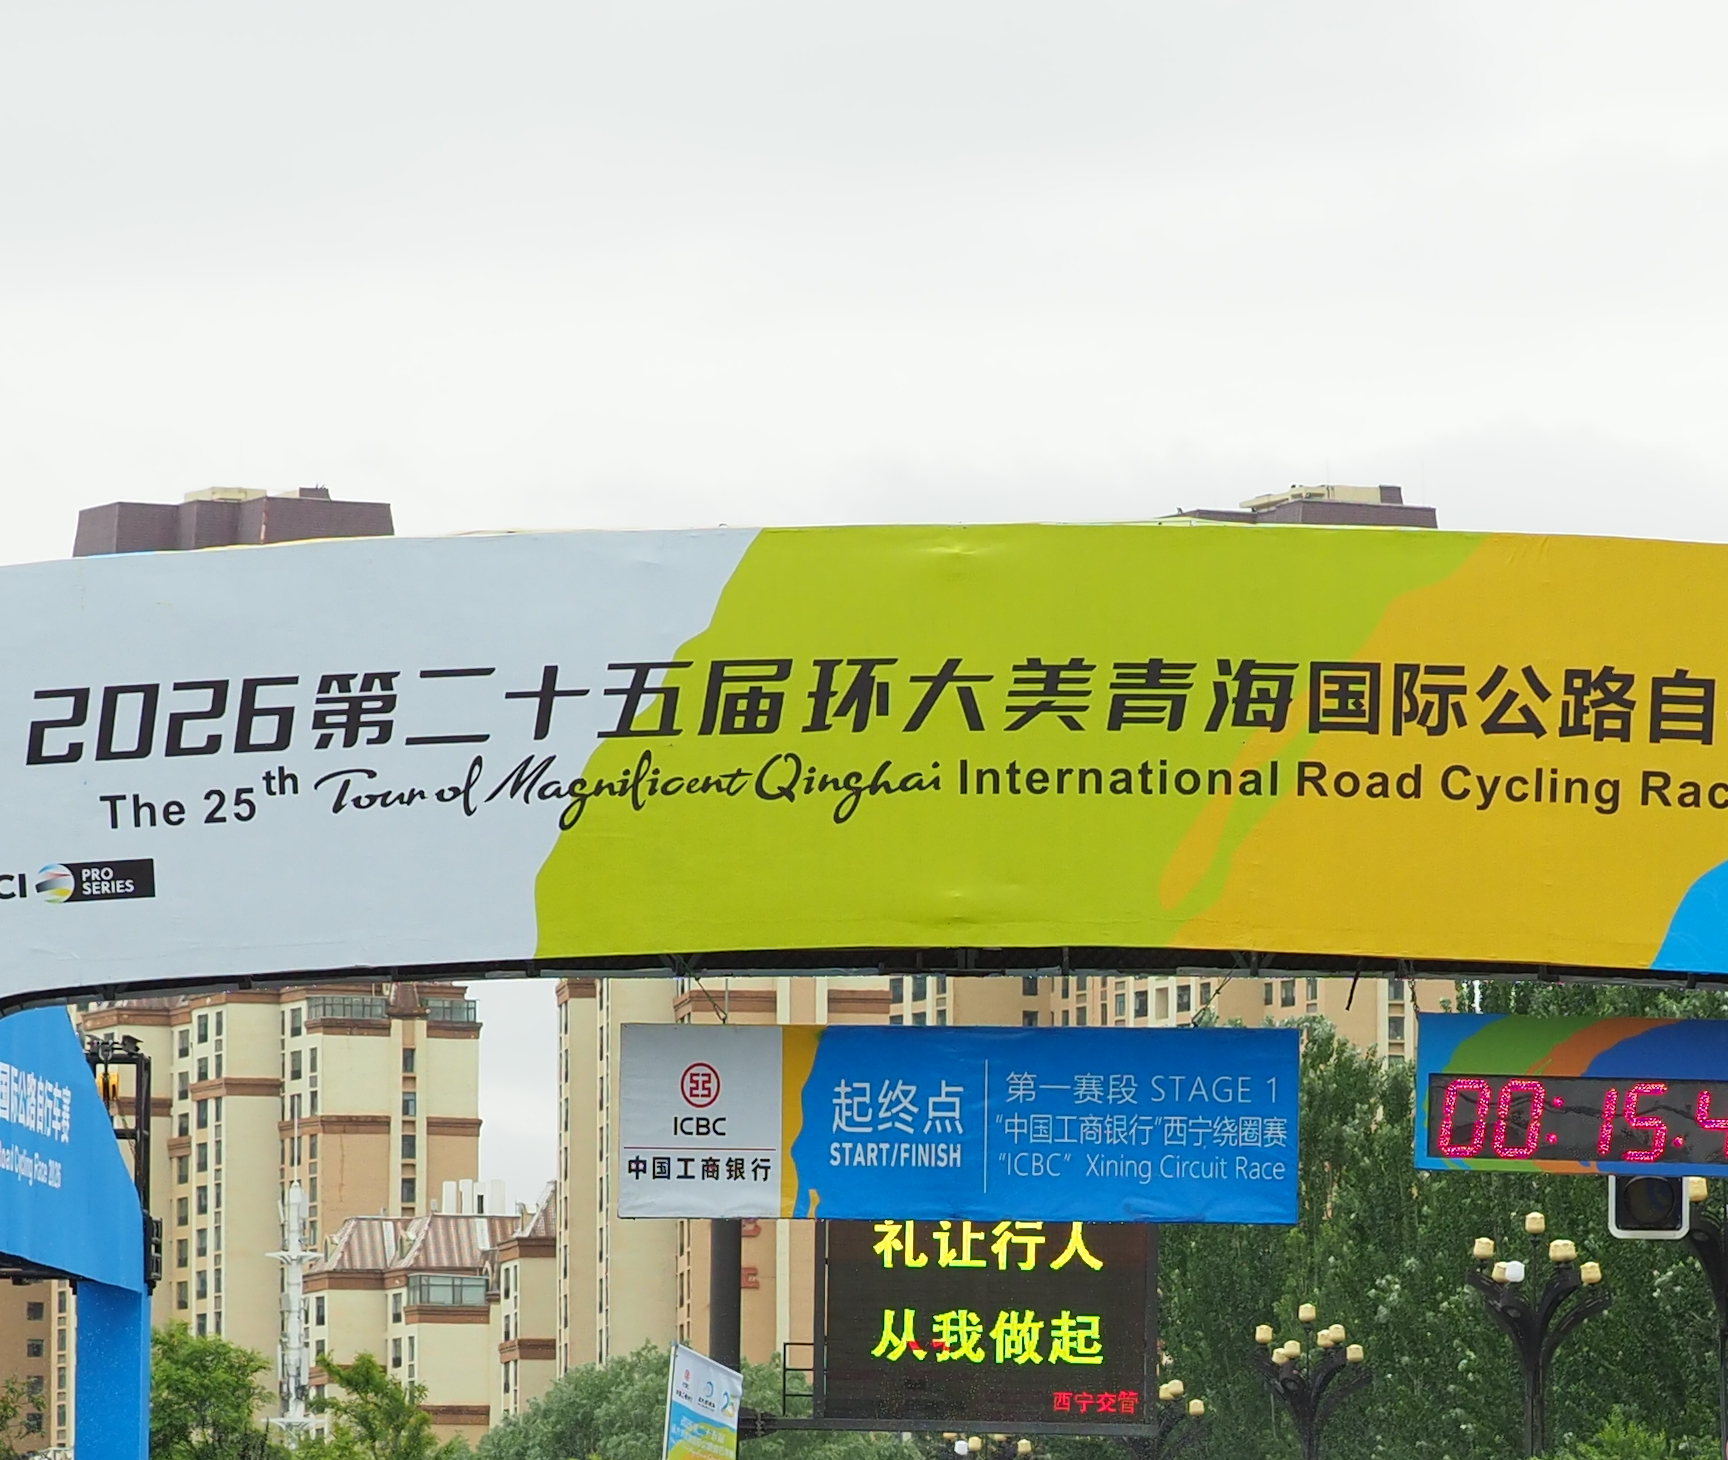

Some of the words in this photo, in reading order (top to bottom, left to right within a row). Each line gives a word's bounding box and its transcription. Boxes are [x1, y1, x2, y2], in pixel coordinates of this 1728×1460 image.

[101, 794, 184, 831] The
[314, 768, 428, 816] Tour
[486, 750, 752, 831] Magnificent
[754, 753, 943, 824] Qinghai
[958, 760, 1280, 799] International
[1297, 760, 1422, 799] Road
[1440, 765, 1620, 815] Cycling
[81, 867, 115, 882] PRO
[81, 879, 136, 895] SERIES
[1006, 1071, 1138, 1105] 第一赛段
[1151, 1075, 1252, 1103] STAGE
[1267, 1077, 1277, 1103] 1
[831, 1079, 964, 1136] 起终点
[673, 1117, 727, 1137] ICBC
[627, 1155, 773, 1184] 中国工商银行
[830, 1142, 961, 1169] START/FINISH
[1086, 1156, 1152, 1185] Xining
[1160, 1155, 1227, 1179] Circuit
[1235, 1156, 1285, 1180] Race
[874, 1220, 1104, 1271] 礼让行人
[872, 1308, 1104, 1366] 从我做起
[1052, 1391, 1139, 1414] 西宁交管
